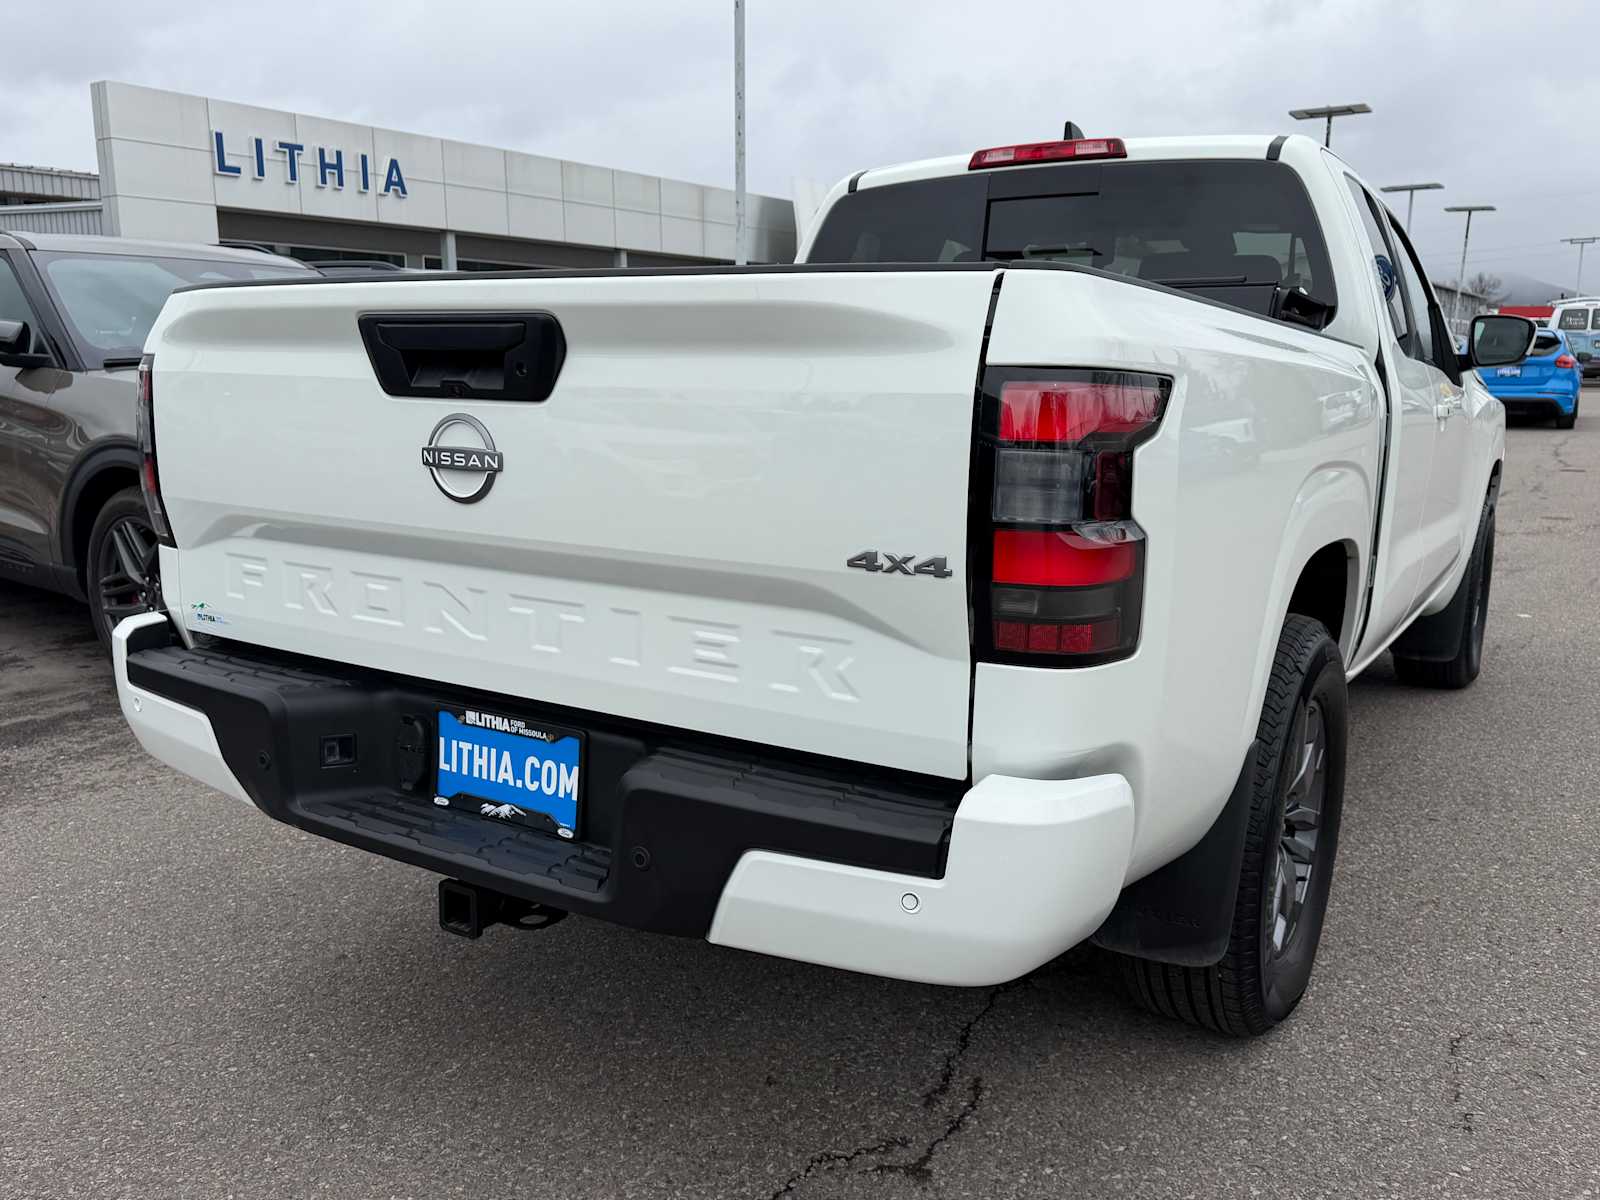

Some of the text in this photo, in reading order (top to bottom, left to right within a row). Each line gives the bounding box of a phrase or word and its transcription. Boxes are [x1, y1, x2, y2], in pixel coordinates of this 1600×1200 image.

[214, 131, 408, 197] LITHIA
[423, 450, 499, 468] NISSAN
[225, 552, 860, 703] FRONTIER
[475, 711, 511, 732] LITHIA
[511, 719, 525, 728] FORD
[519, 728, 547, 739] MISSOULA
[438, 736, 580, 801] LITHIA.COM
